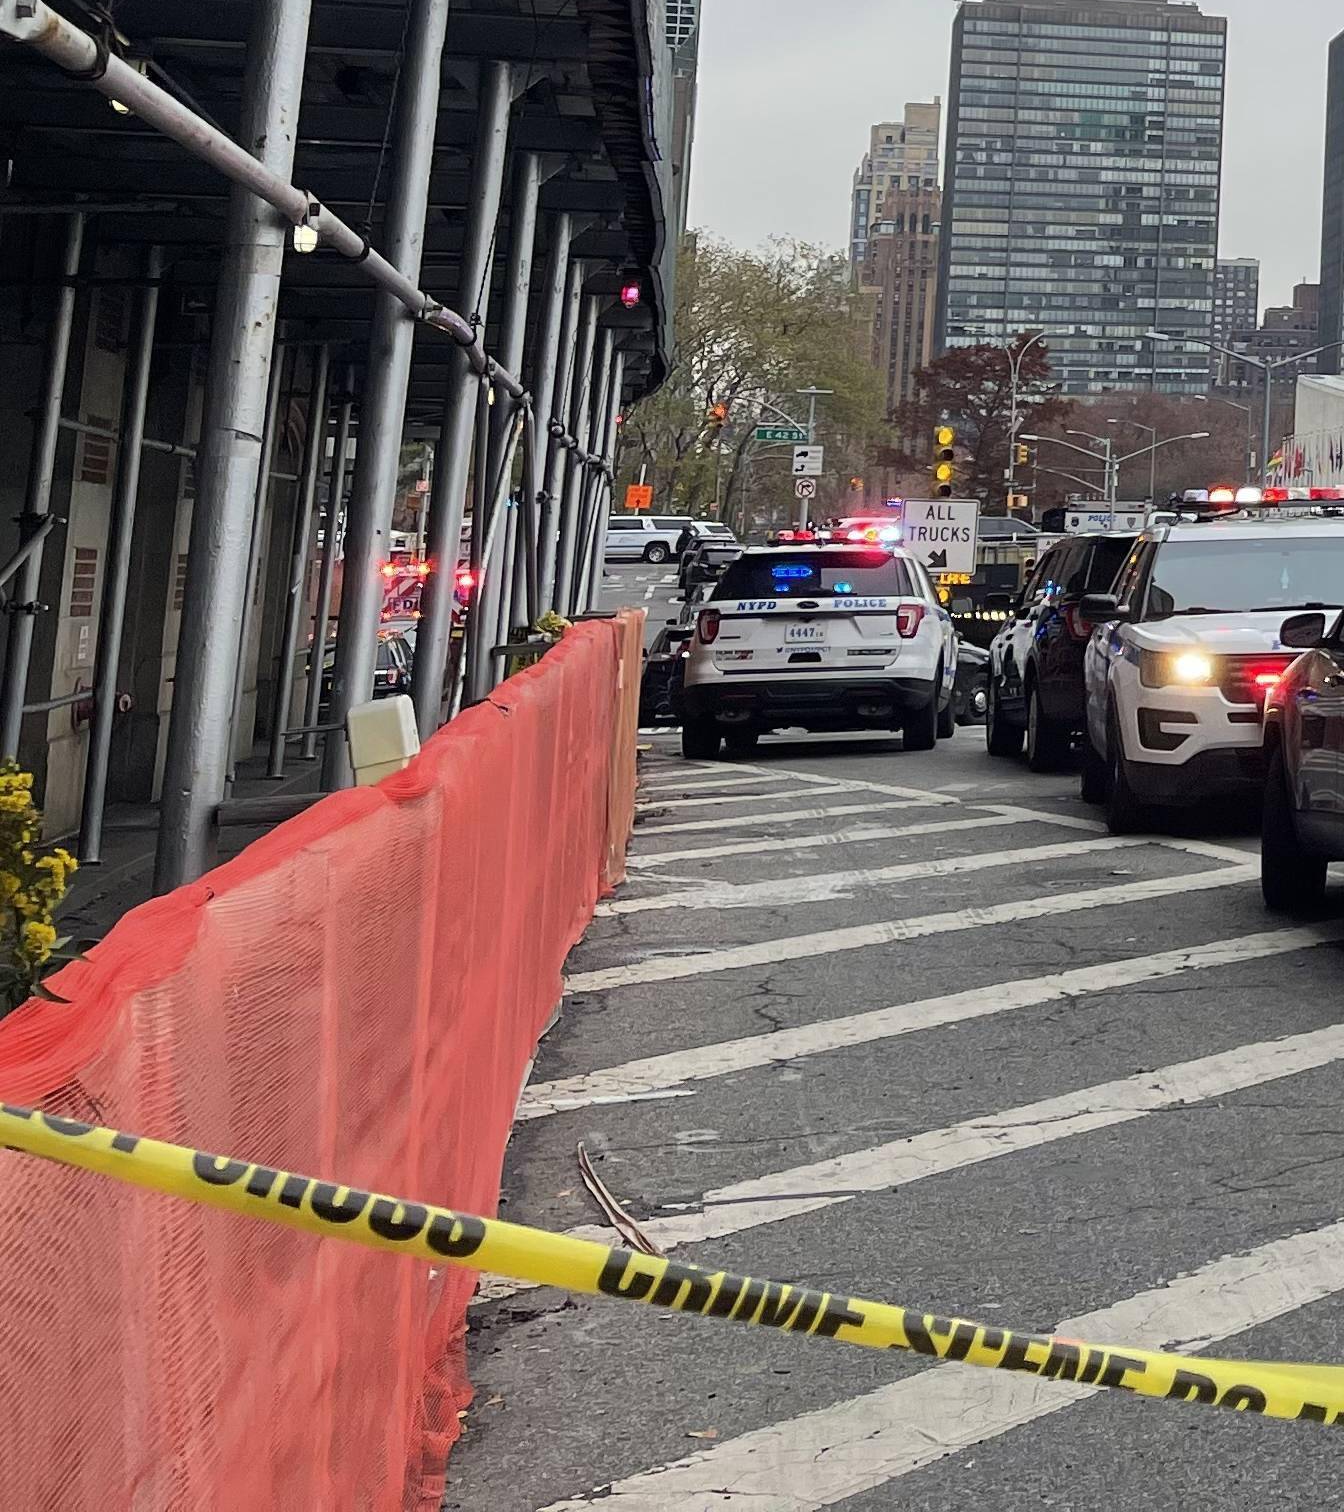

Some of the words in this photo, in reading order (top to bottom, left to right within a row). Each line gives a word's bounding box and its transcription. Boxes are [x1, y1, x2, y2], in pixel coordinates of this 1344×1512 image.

[925, 505, 956, 521] ALL
[909, 526, 971, 543] TRUCKS
[736, 600, 777, 611] NYPD
[833, 598, 887, 609] POLICE
[789, 626, 815, 638] 4447
